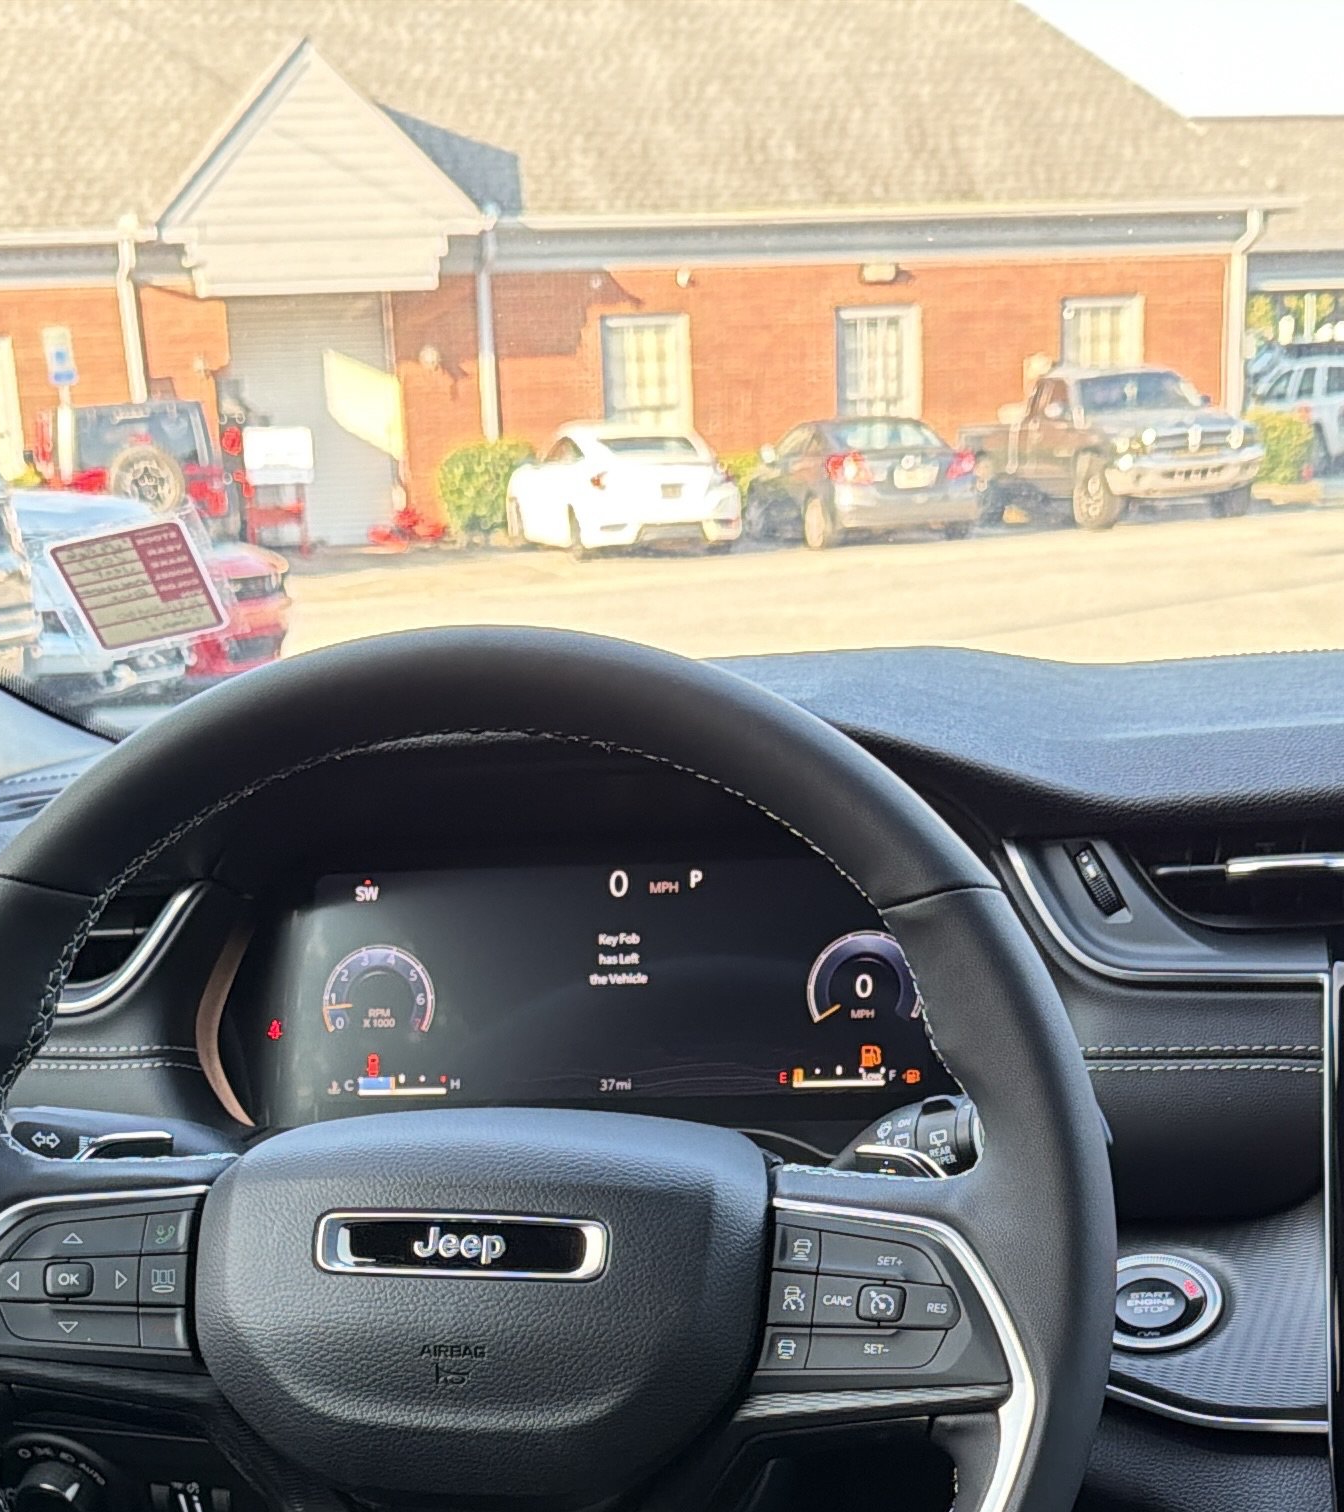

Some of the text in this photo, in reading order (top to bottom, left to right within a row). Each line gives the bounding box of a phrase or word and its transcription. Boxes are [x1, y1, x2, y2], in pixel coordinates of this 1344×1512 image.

[609, 870, 679, 898] 0 MPH
[689, 869, 703, 889] P
[355, 885, 379, 901] SW
[598, 933, 641, 947] Key Fob
[598, 952, 640, 965] has Left
[340, 969, 349, 982] 2
[409, 969, 418, 982] 5
[589, 973, 649, 985] the Vehicle
[855, 973, 873, 999] 0
[415, 993, 426, 1006] 6
[367, 1008, 391, 1017] RPM
[850, 1008, 876, 1019] MPH
[335, 1017, 345, 1030] 0
[373, 1018, 396, 1028] 1000
[779, 1071, 788, 1083] E
[888, 1069, 897, 1081] F
[343, 1079, 355, 1092] C
[450, 1078, 461, 1090] H
[897, 1118, 912, 1128] ON
[929, 1146, 950, 1158] REAR
[413, 1226, 506, 1265] Jeep
[877, 1256, 903, 1267] SET+
[57, 1273, 80, 1286] OK
[822, 1295, 853, 1307] CANC
[1130, 1291, 1173, 1299] START
[926, 1302, 948, 1314] RES
[1126, 1298, 1175, 1307] ENGINE
[1133, 1306, 1169, 1314] STOP
[420, 1345, 486, 1359] AIRBAG
